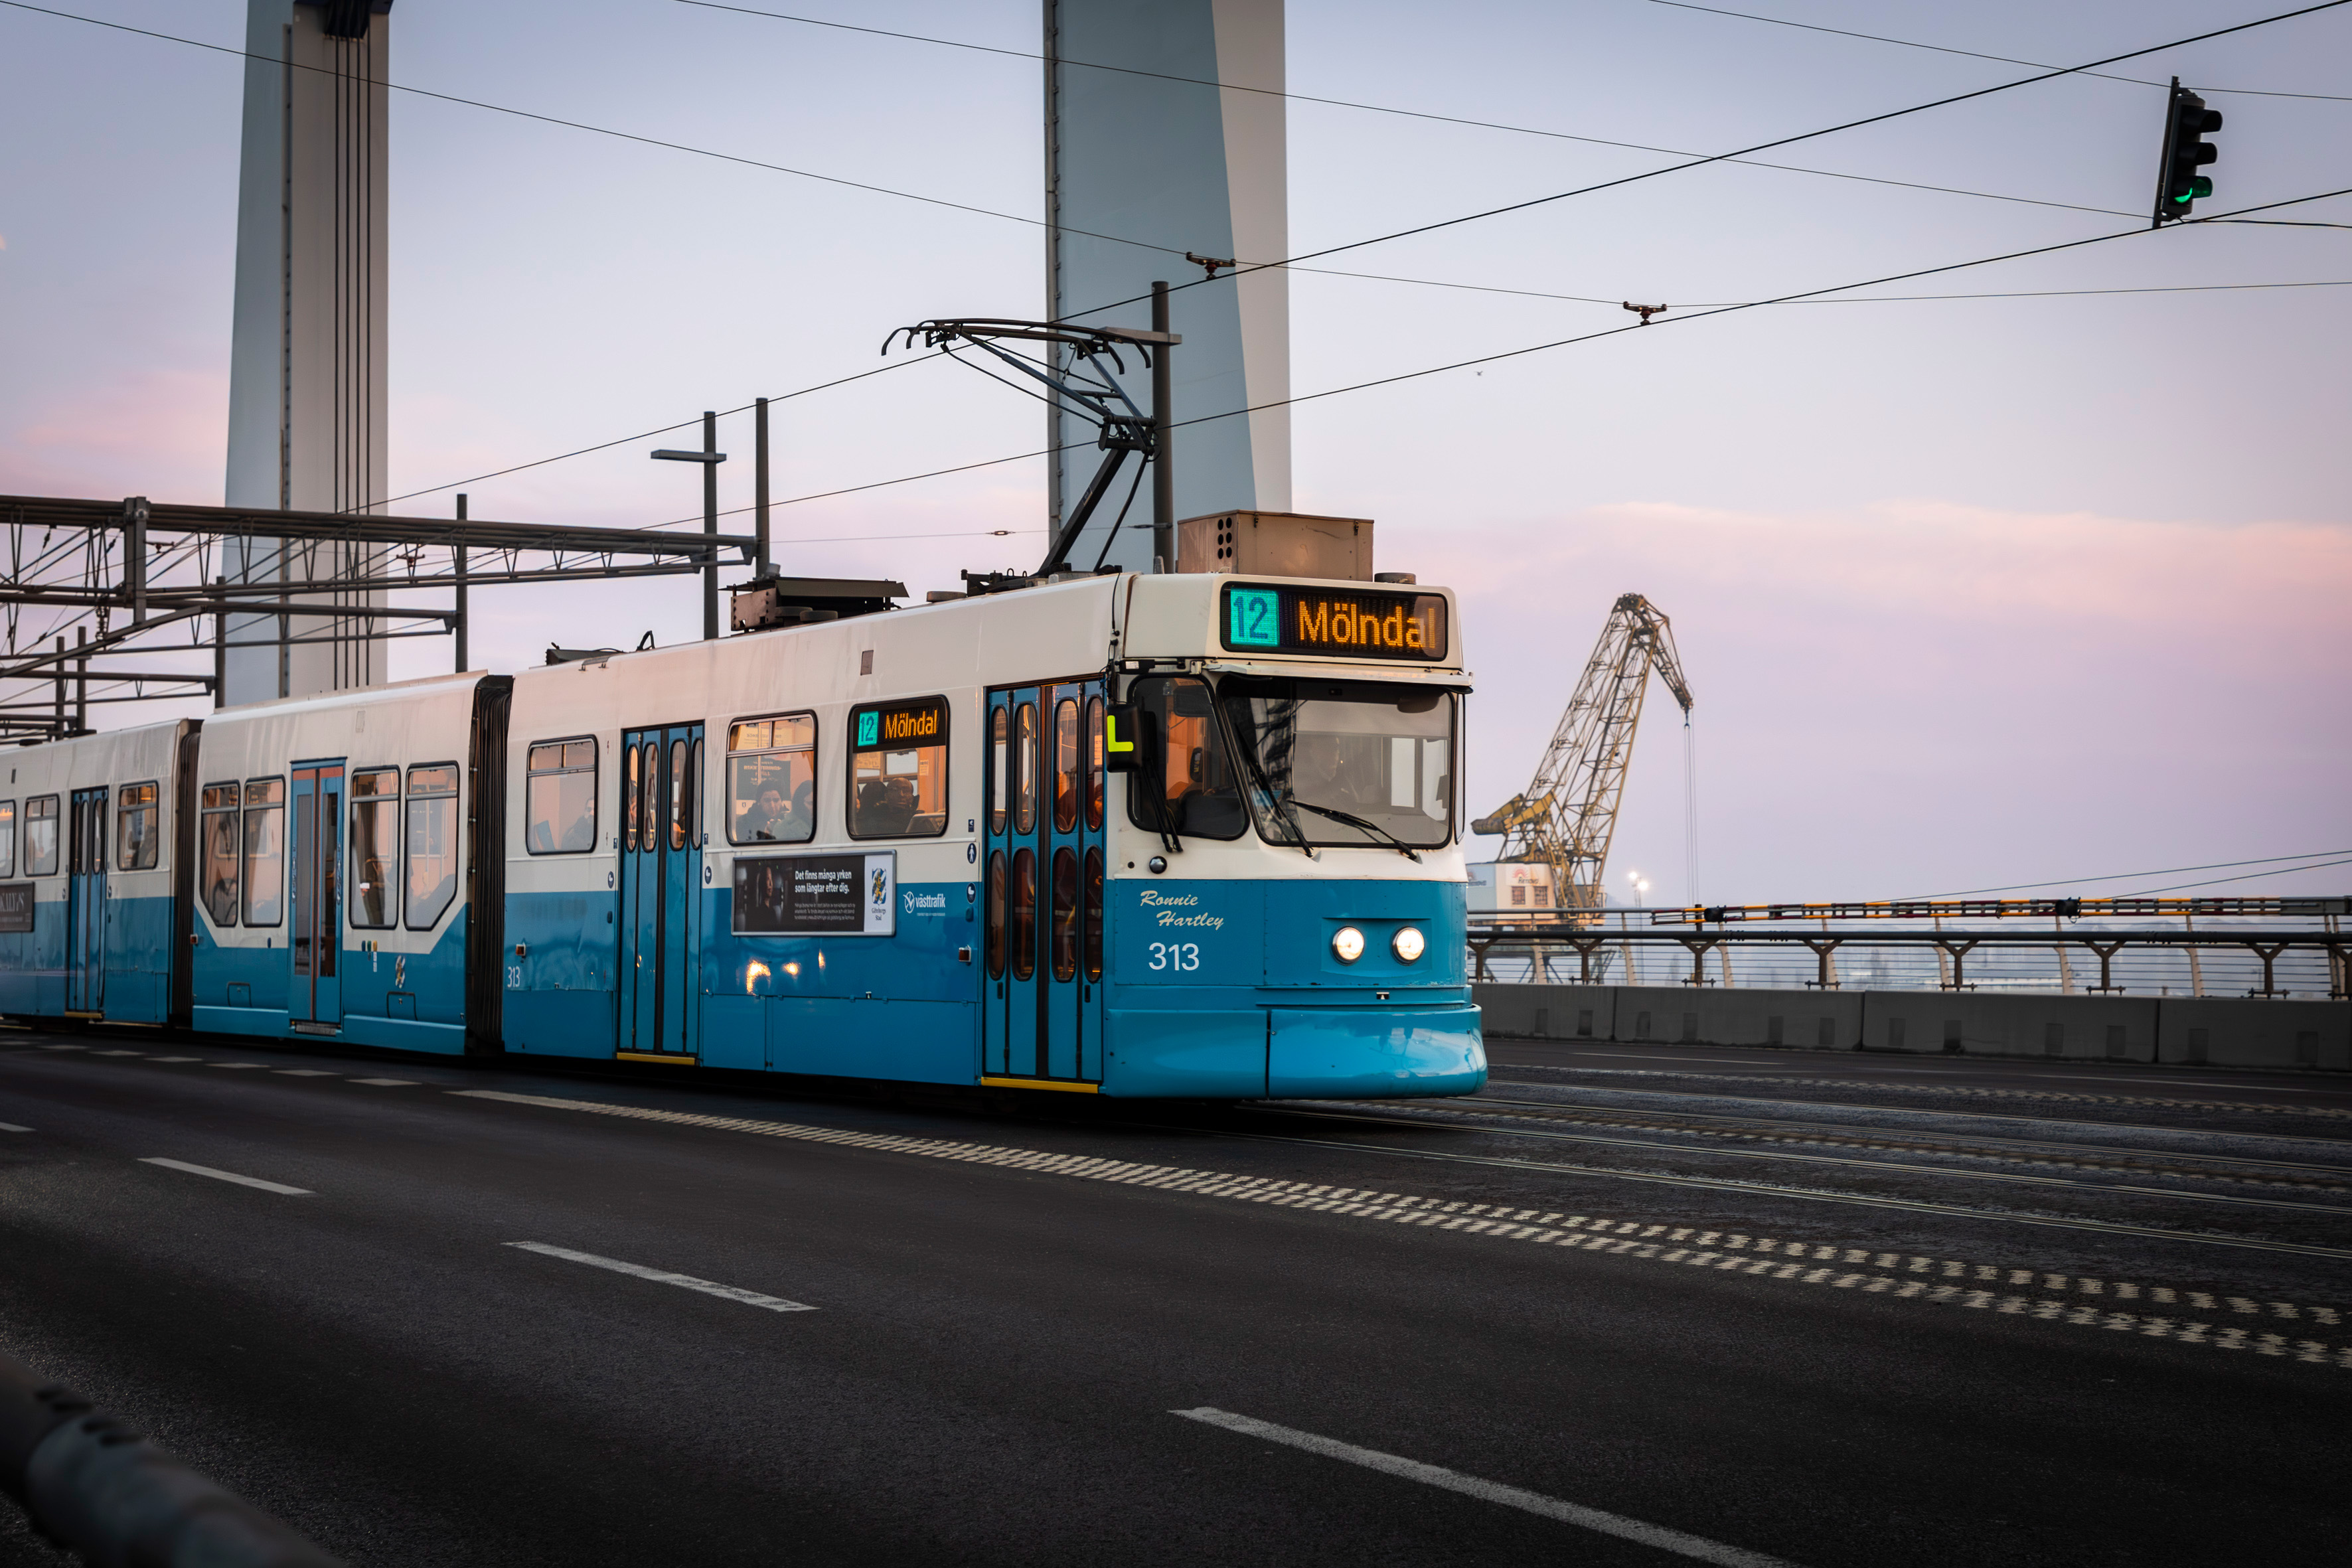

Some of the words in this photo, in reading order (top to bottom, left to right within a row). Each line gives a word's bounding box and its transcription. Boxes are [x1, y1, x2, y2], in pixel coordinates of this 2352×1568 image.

[1232, 595, 1269, 639] 12
[1299, 600, 1436, 649] Mölndal
[860, 716, 874, 742] 12
[885, 709, 938, 740] Mölndal
[795, 870, 804, 880] Det
[805, 870, 817, 880] finns
[818, 868, 836, 882] många
[836, 869, 852, 882] yrken
[795, 885, 806, 894] som
[806, 882, 825, 894] längtar
[825, 882, 838, 893] efter
[838, 882, 850, 894] dig.
[1140, 890, 1199, 907] Ronnie
[915, 893, 946, 908] västtrafik
[1156, 910, 1224, 931] Hartley
[1148, 942, 1200, 971] 313
[507, 966, 520, 988] 313
